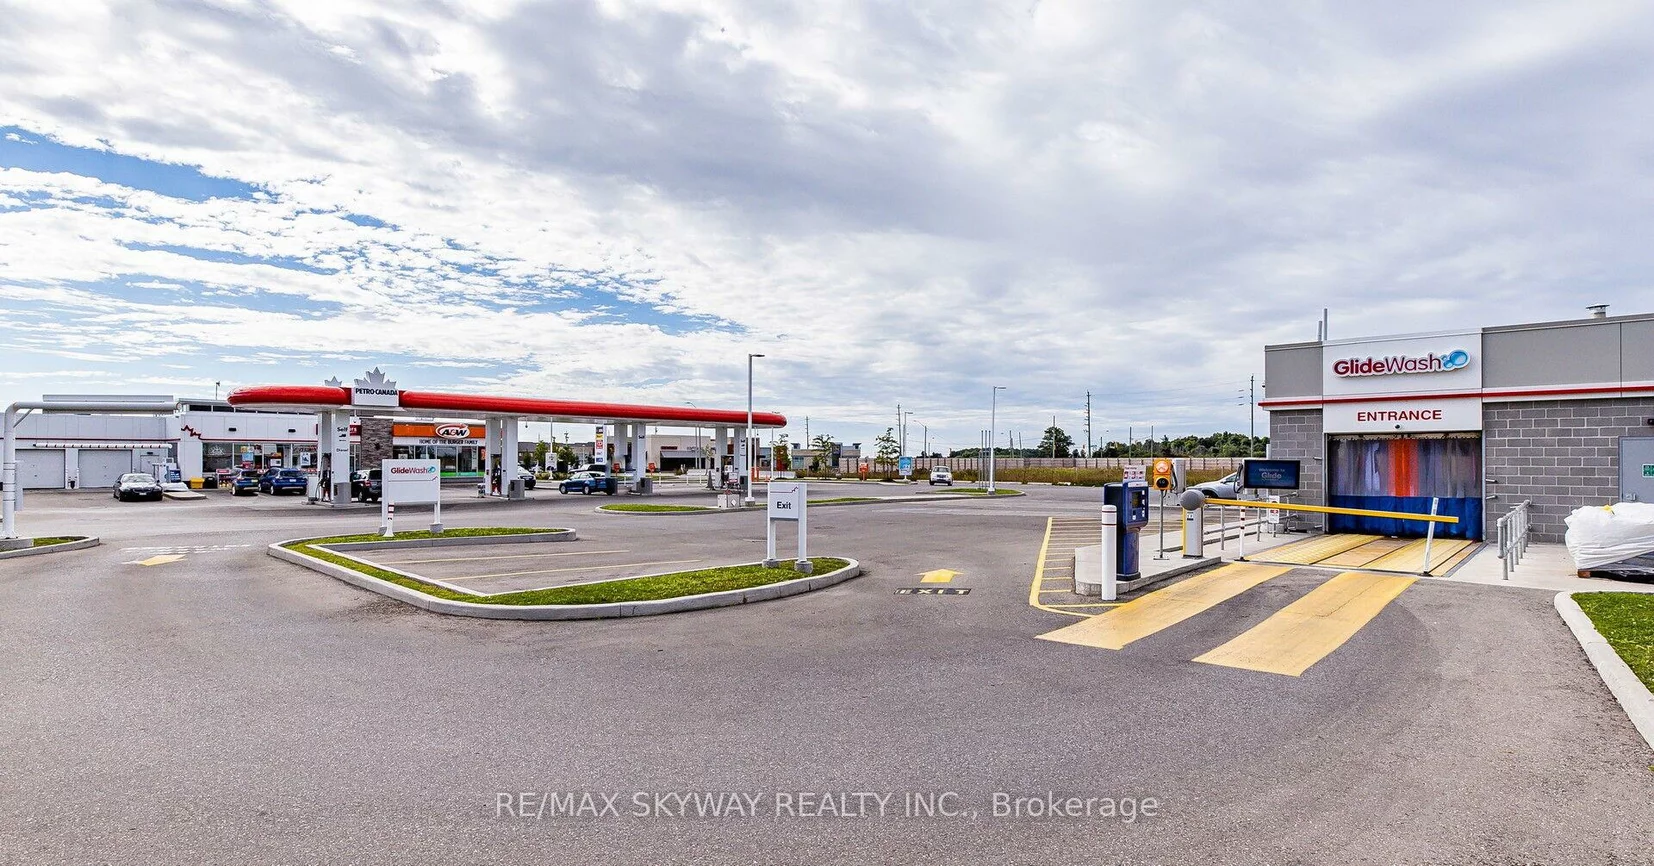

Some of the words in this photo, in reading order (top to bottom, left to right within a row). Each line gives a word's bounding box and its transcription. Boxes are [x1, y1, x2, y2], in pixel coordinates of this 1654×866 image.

[1334, 353, 1442, 375] GlideWash
[1357, 409, 1442, 422] ENTRANCE
[441, 429, 467, 437] A&W
[391, 466, 428, 474] GlideWash
[776, 501, 792, 510] Exit
